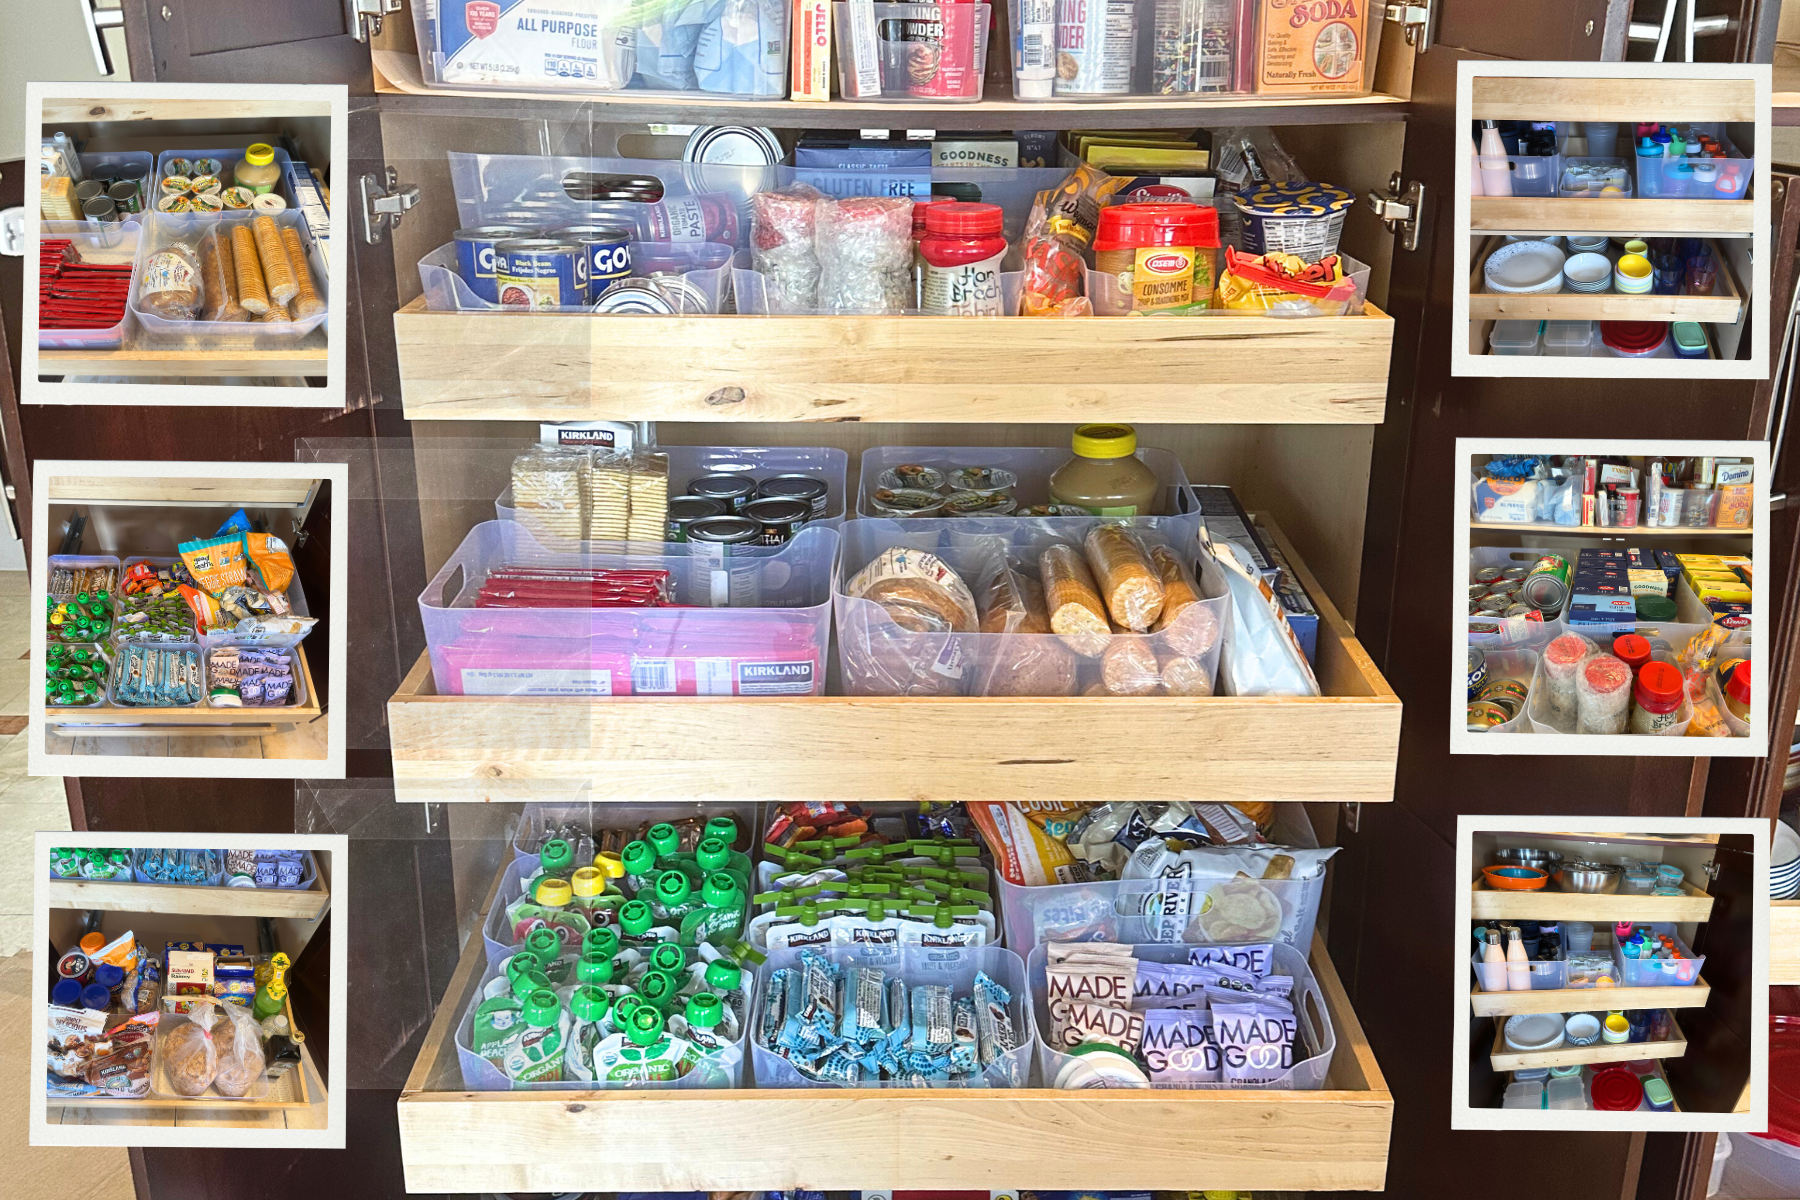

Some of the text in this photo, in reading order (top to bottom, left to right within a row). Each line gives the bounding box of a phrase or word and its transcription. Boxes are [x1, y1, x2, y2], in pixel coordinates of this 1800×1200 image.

[908, 6, 941, 20] KING
[1289, 0, 1358, 28] SODA
[517, 17, 598, 38] ALL PURPOSE
[906, 22, 944, 38] OWDER
[571, 37, 598, 50] FLOUR
[1266, 71, 1297, 79] Naturally
[940, 150, 1009, 167] GOODNESS
[813, 178, 915, 197] GLUTEN FREE
[654, 205, 666, 238] KIRKLAND
[667, 204, 682, 236] ORGANIC
[684, 200, 701, 238] PASTE
[512, 266, 557, 275] Frijoles Negros
[515, 259, 532, 267] Black
[1151, 259, 1175, 268] OSEM
[561, 431, 614, 441] KIRKLAND
[1721, 468, 1749, 482] Domino
[221, 566, 247, 587] STRAW
[211, 660, 237, 669] MADE
[744, 665, 810, 677] KIRKLAND
[240, 679, 263, 688] MAD
[228, 849, 254, 859] MADE
[1163, 866, 1184, 916] RIVER
[789, 930, 830, 944] KIRKLAND
[855, 929, 895, 939] KIRKLAND
[1049, 975, 1127, 999] MADE
[1068, 1003, 1144, 1042] MADE
[1143, 1024, 1218, 1050] MADE
[1220, 1018, 1296, 1045] MADE
[1146, 1045, 1222, 1073] GOOD
[1225, 1044, 1293, 1070] GOOD
[614, 1063, 671, 1078] ORGANIC
[1230, 1077, 1267, 1089] GRANOLA
